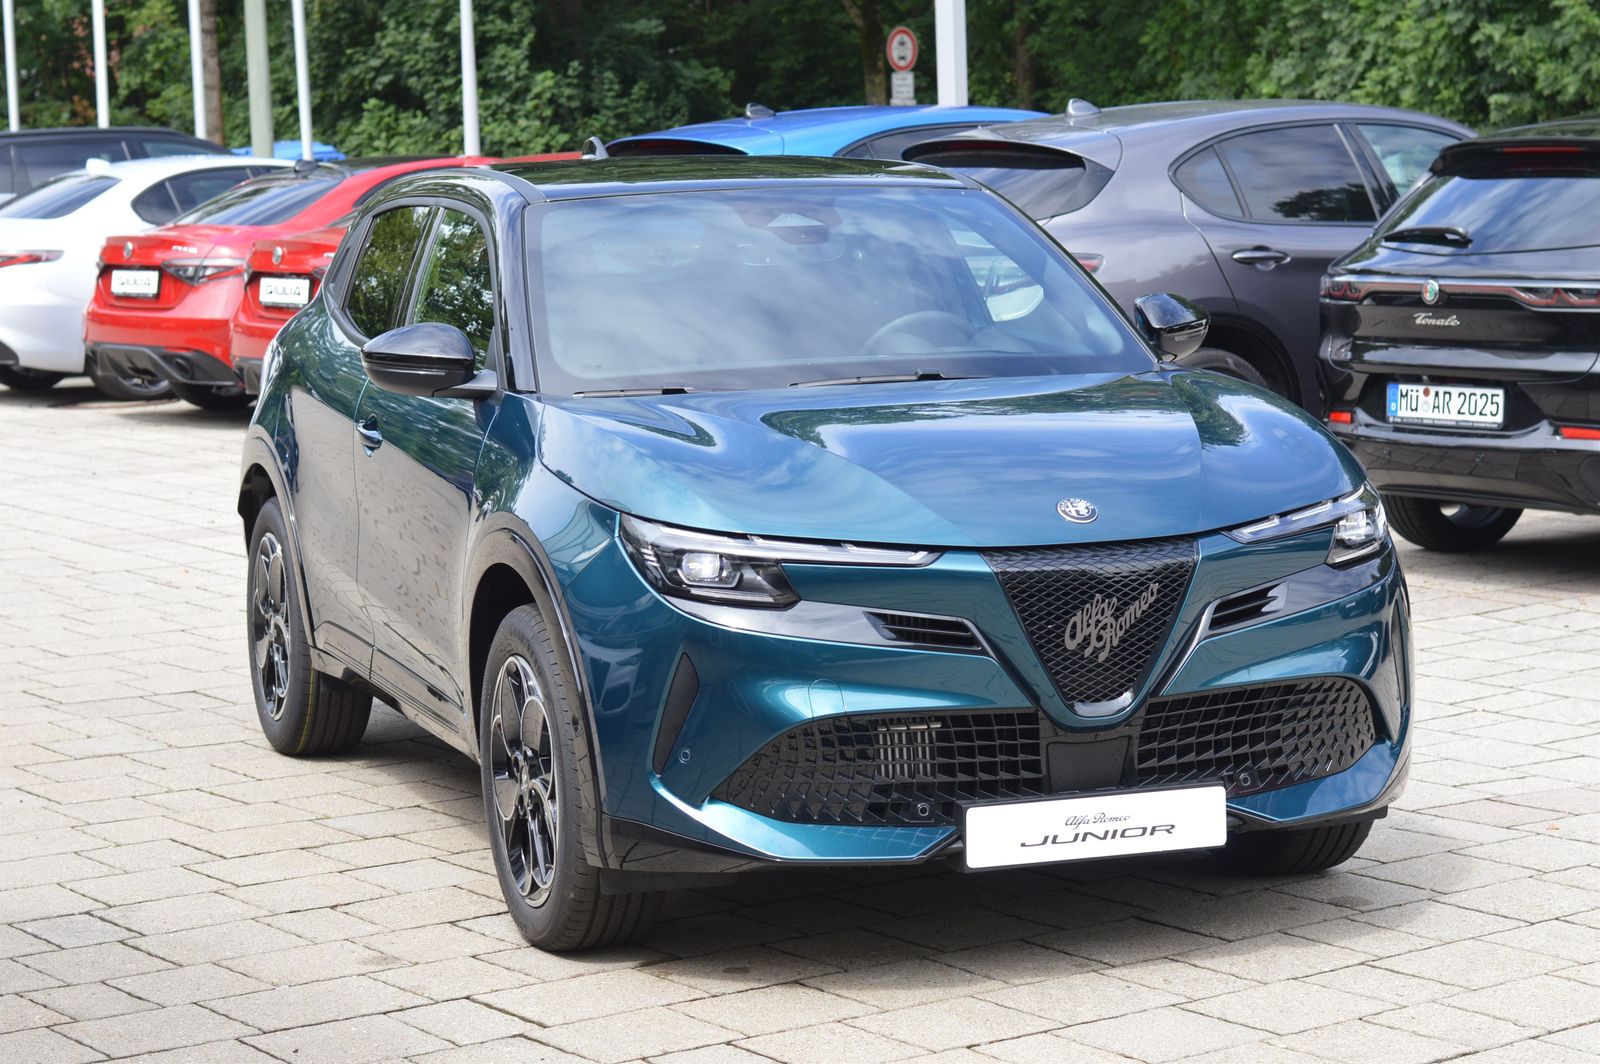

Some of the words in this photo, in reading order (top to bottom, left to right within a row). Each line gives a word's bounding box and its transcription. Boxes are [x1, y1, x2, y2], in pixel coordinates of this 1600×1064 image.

[1413, 313, 1460, 326] Tonale
[1432, 390, 1452, 414] AR
[1457, 392, 1500, 417] 2025
[1064, 593, 1118, 658] Alfa
[1094, 583, 1159, 663] Romeo
[1064, 814, 1092, 830] Alfa
[1093, 812, 1131, 825] Romeo
[1020, 824, 1176, 847] JUNIOR
